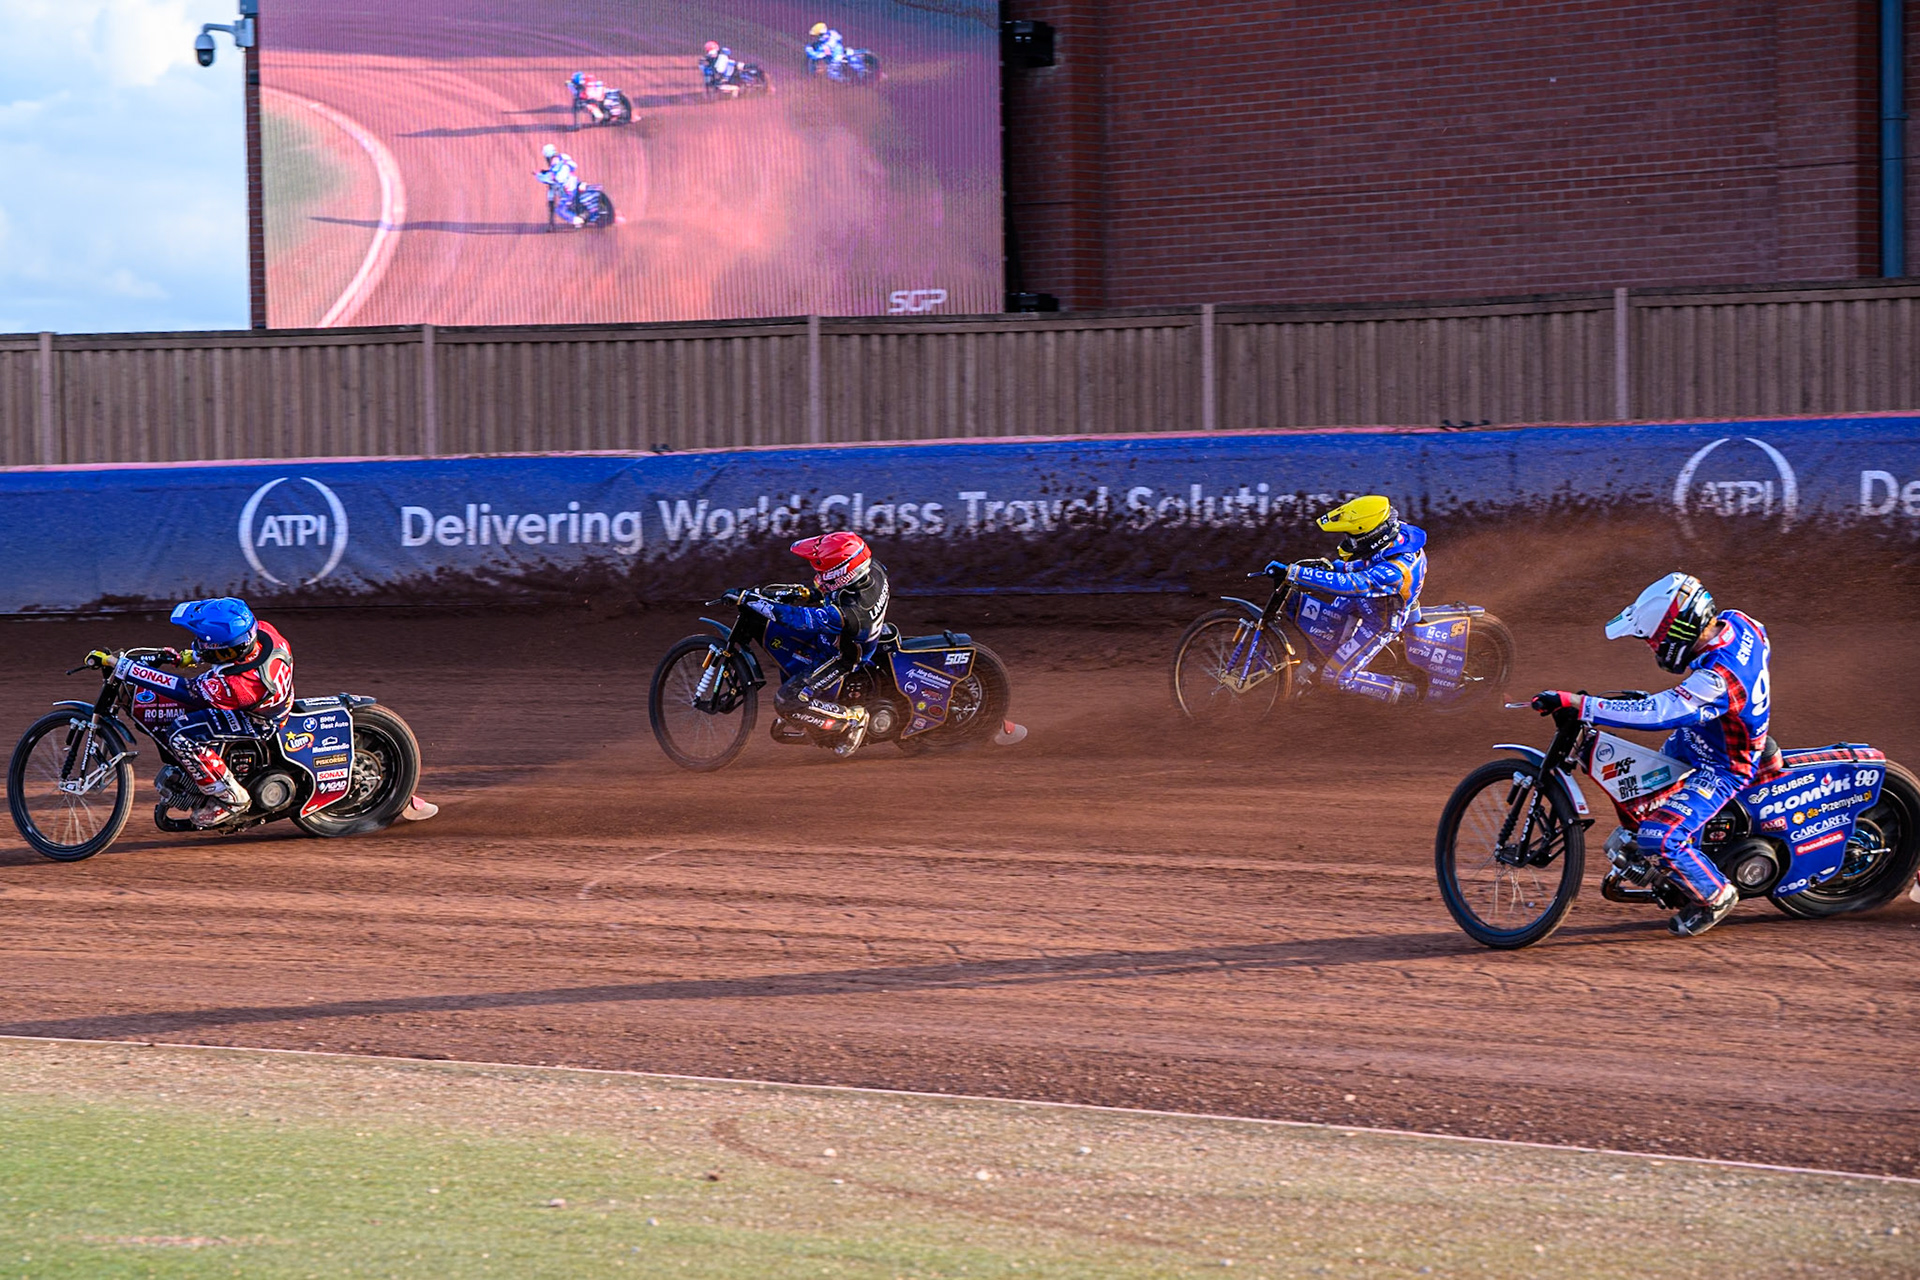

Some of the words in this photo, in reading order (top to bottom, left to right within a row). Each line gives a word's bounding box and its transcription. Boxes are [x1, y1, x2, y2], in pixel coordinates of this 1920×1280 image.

[888, 289, 948, 313] SGP
[1700, 481, 1774, 517] ATPI
[256, 514, 327, 547] ATPI
[401, 501, 643, 555] Delivering
[657, 494, 800, 540] World
[817, 492, 945, 535] Class
[958, 486, 1109, 532] Travel
[1302, 567, 1334, 580] MCG
[944, 652, 971, 666] 505
[132, 666, 173, 686] SONAX
[320, 715, 336, 723] BMW
[319, 771, 344, 780] SONAX
[1854, 769, 1880, 787] 99
[1790, 812, 1851, 842] GARCAREK
